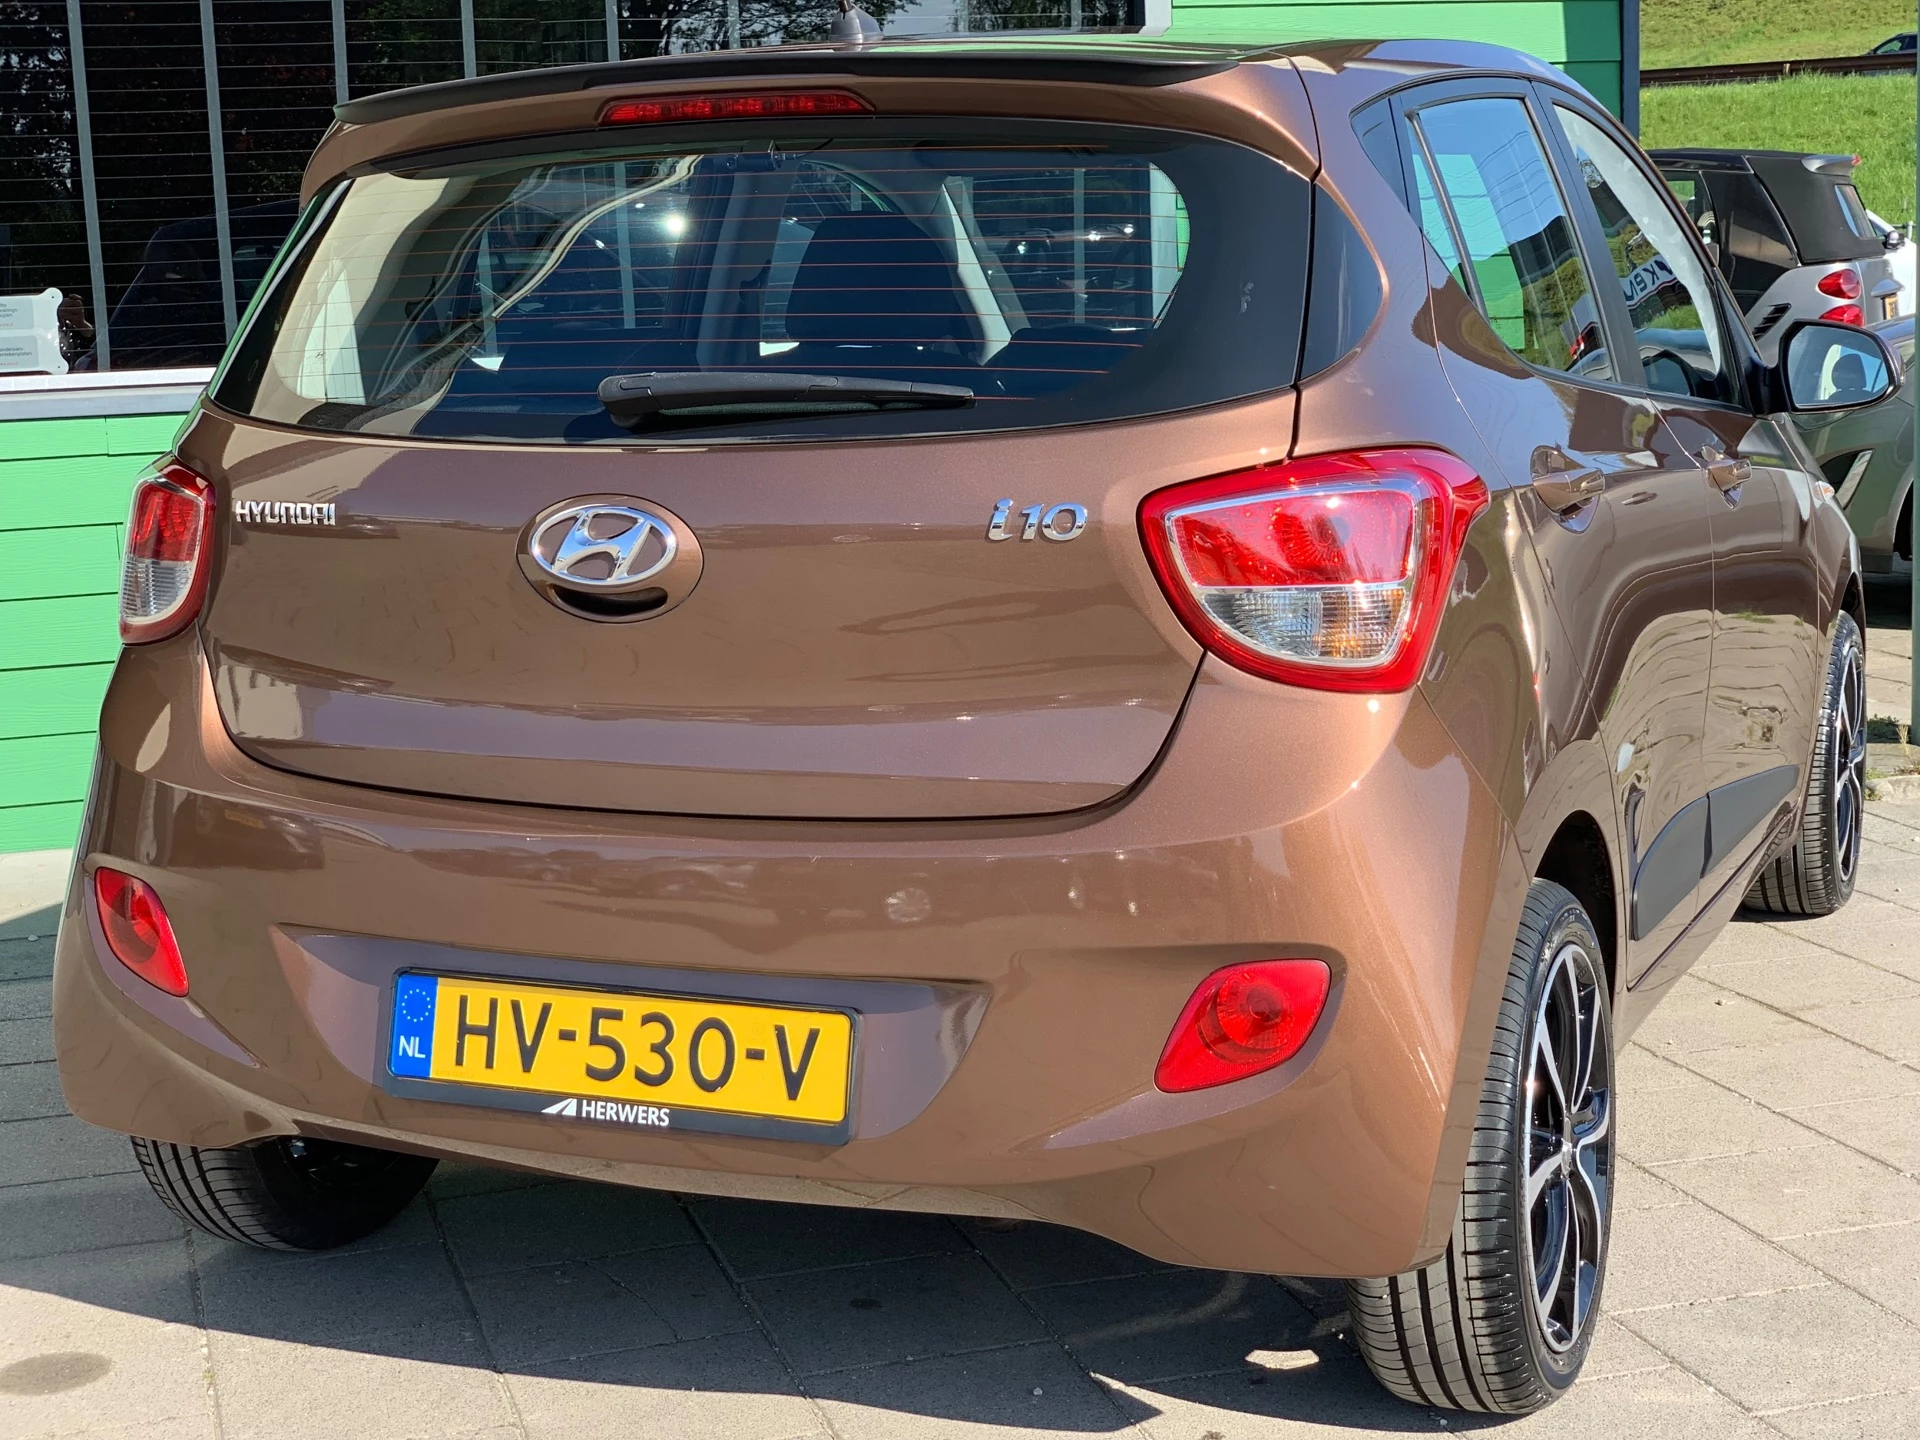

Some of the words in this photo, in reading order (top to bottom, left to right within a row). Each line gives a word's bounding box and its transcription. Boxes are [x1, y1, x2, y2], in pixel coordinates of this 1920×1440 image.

[235, 500, 336, 526] HYUNDAI
[988, 498, 1088, 541] i10
[398, 1034, 426, 1059] NL
[455, 994, 820, 1101] HV-530-V
[580, 1099, 671, 1127] HERWERS
